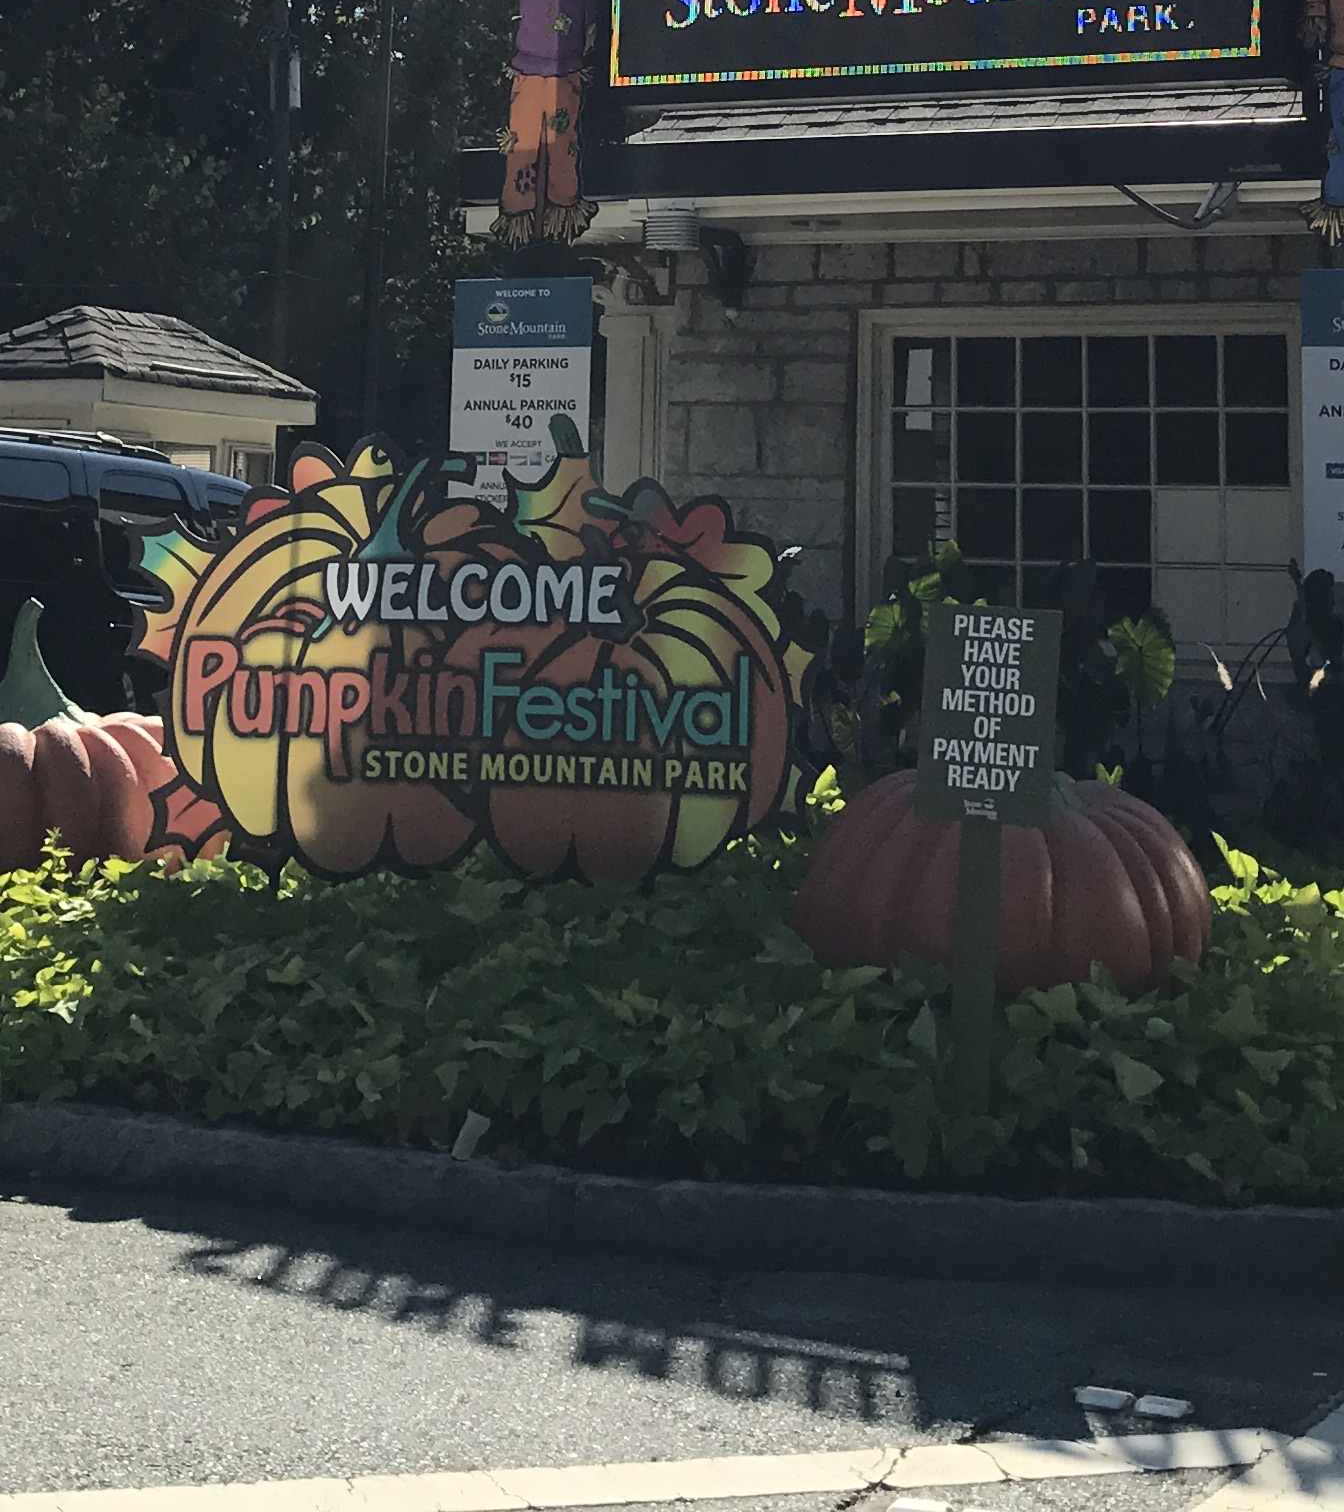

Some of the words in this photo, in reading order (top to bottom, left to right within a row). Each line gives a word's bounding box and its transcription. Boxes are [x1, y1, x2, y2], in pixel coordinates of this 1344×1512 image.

[495, 289, 536, 297] WELCOME
[538, 289, 550, 297] TO
[474, 359, 508, 370] DAILY
[513, 358, 569, 369] PARKING
[509, 372, 531, 388] $15
[464, 400, 516, 411] ANNUAL
[520, 399, 577, 410] PARKING
[505, 414, 533, 429] $40
[495, 440, 508, 448] WE
[509, 440, 542, 448] ACCEPT
[324, 561, 623, 623] WELCOME
[953, 614, 1035, 641] PLEASE
[963, 639, 1021, 665] HAVE
[961, 664, 1021, 690] YOUR
[942, 688, 1036, 717] METHOD
[973, 716, 1002, 739] OF
[932, 738, 1039, 768] PAYMENT
[364, 750, 468, 781] STONE
[479, 754, 652, 788] MOUNTAIN
[665, 758, 748, 790] PARK
[947, 764, 1022, 792] READY
